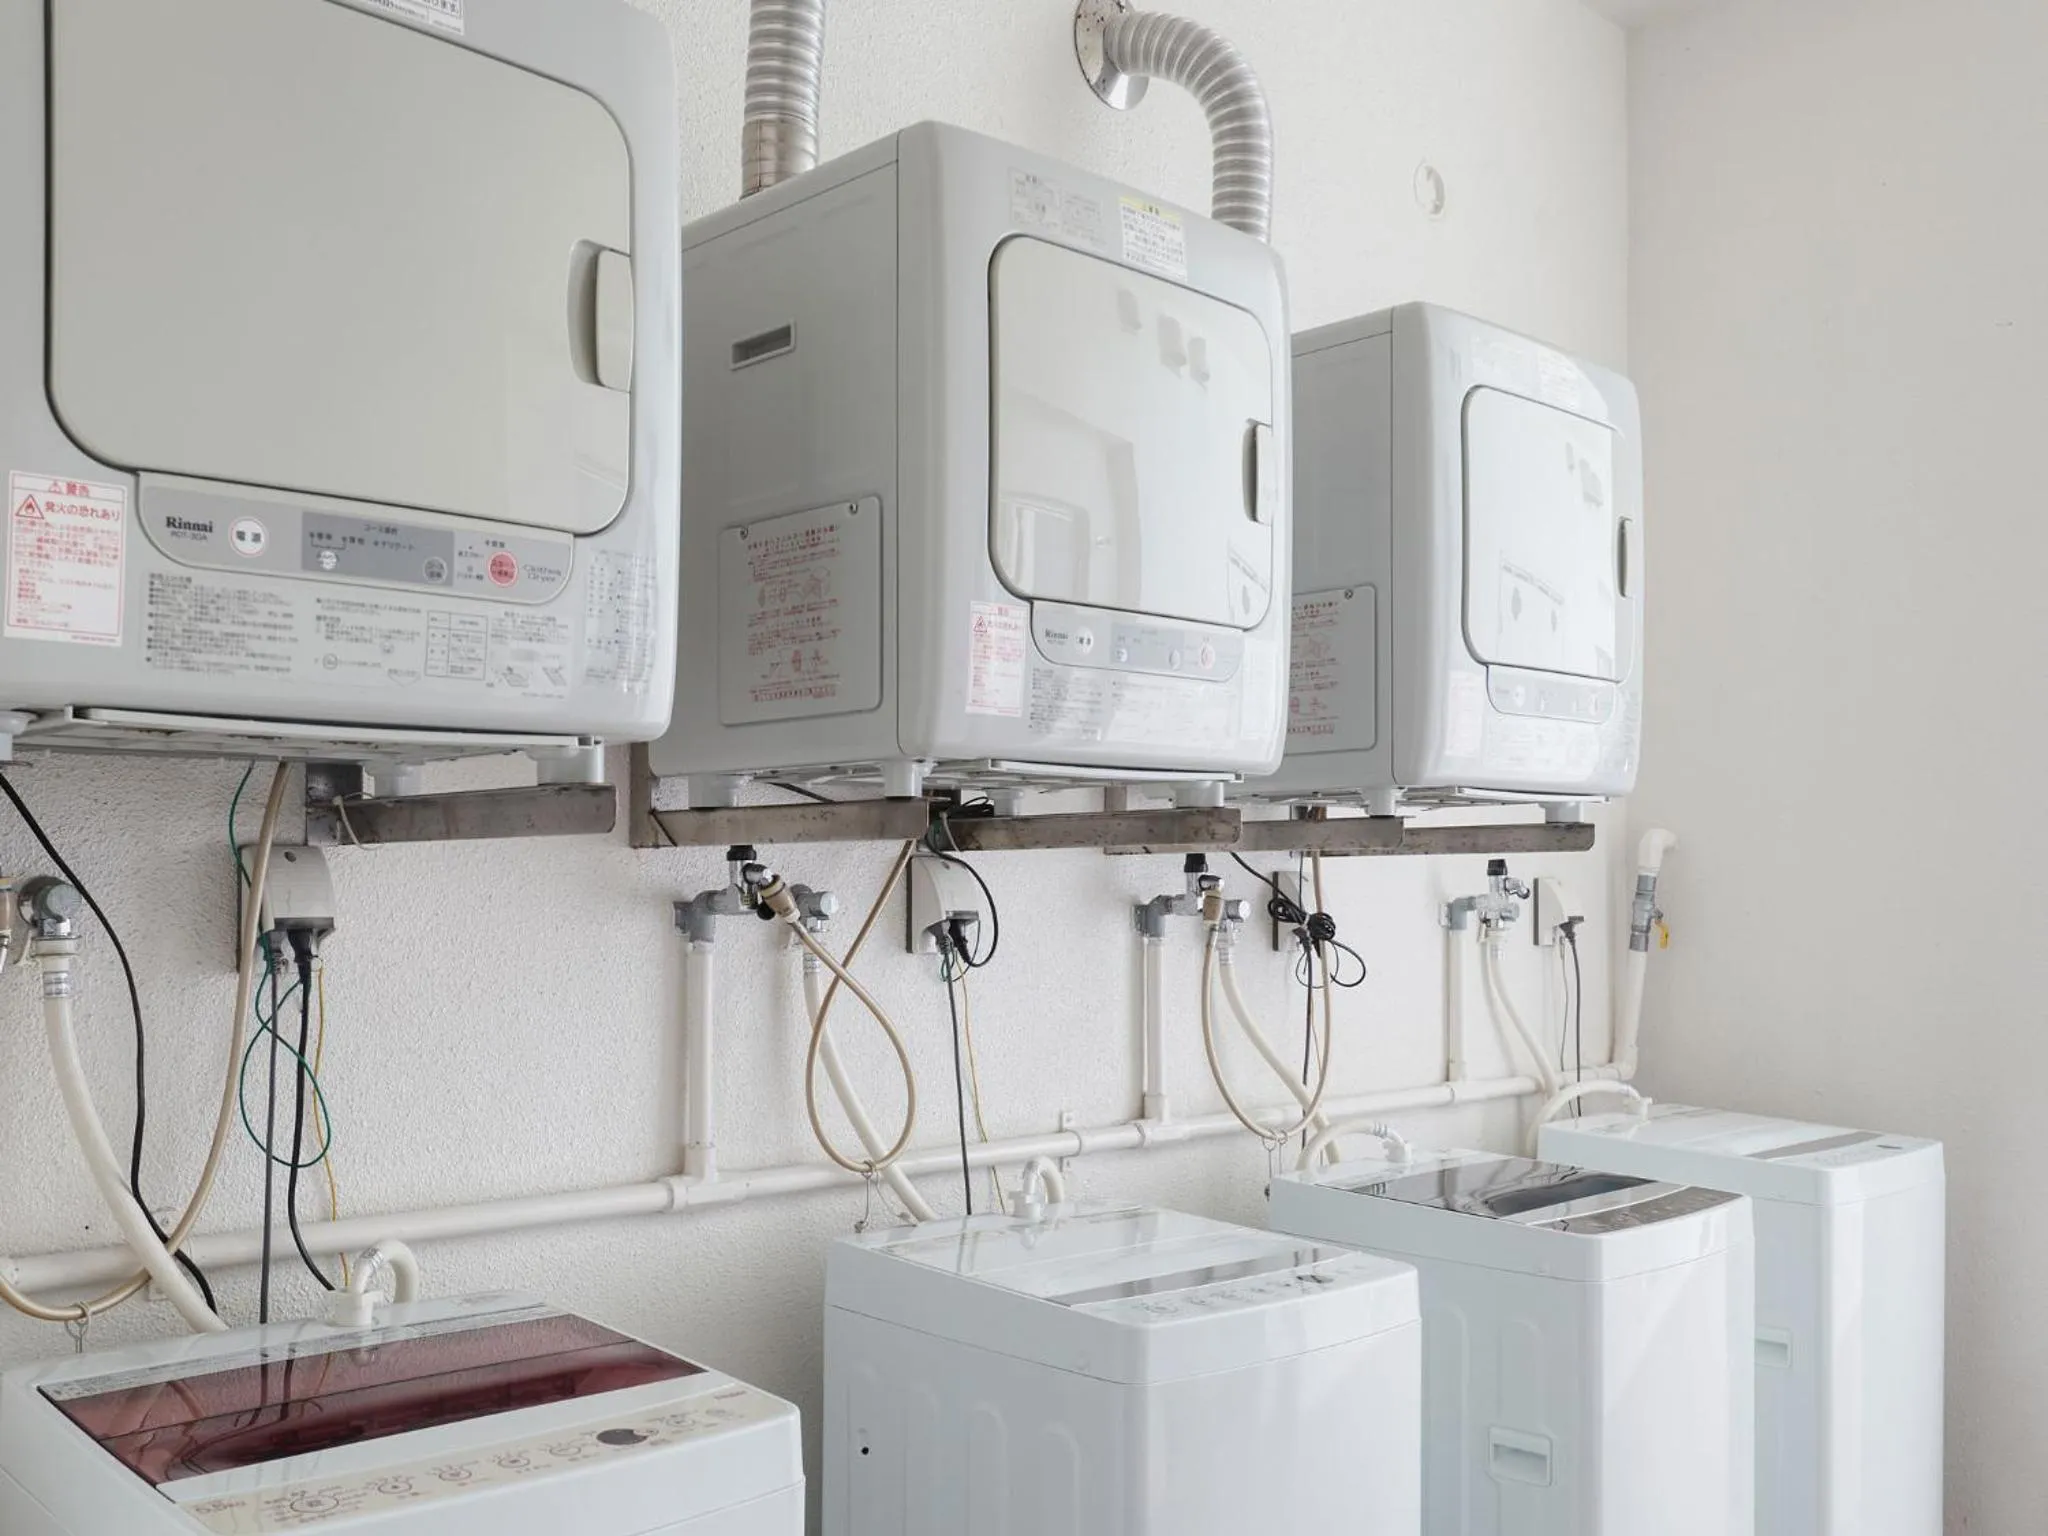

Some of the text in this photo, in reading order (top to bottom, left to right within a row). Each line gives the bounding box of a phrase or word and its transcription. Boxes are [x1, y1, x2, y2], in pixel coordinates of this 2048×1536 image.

[66, 481, 89, 496] 警告
[44, 500, 121, 521] 発火の恐れあり
[165, 516, 214, 533] Rinnai
